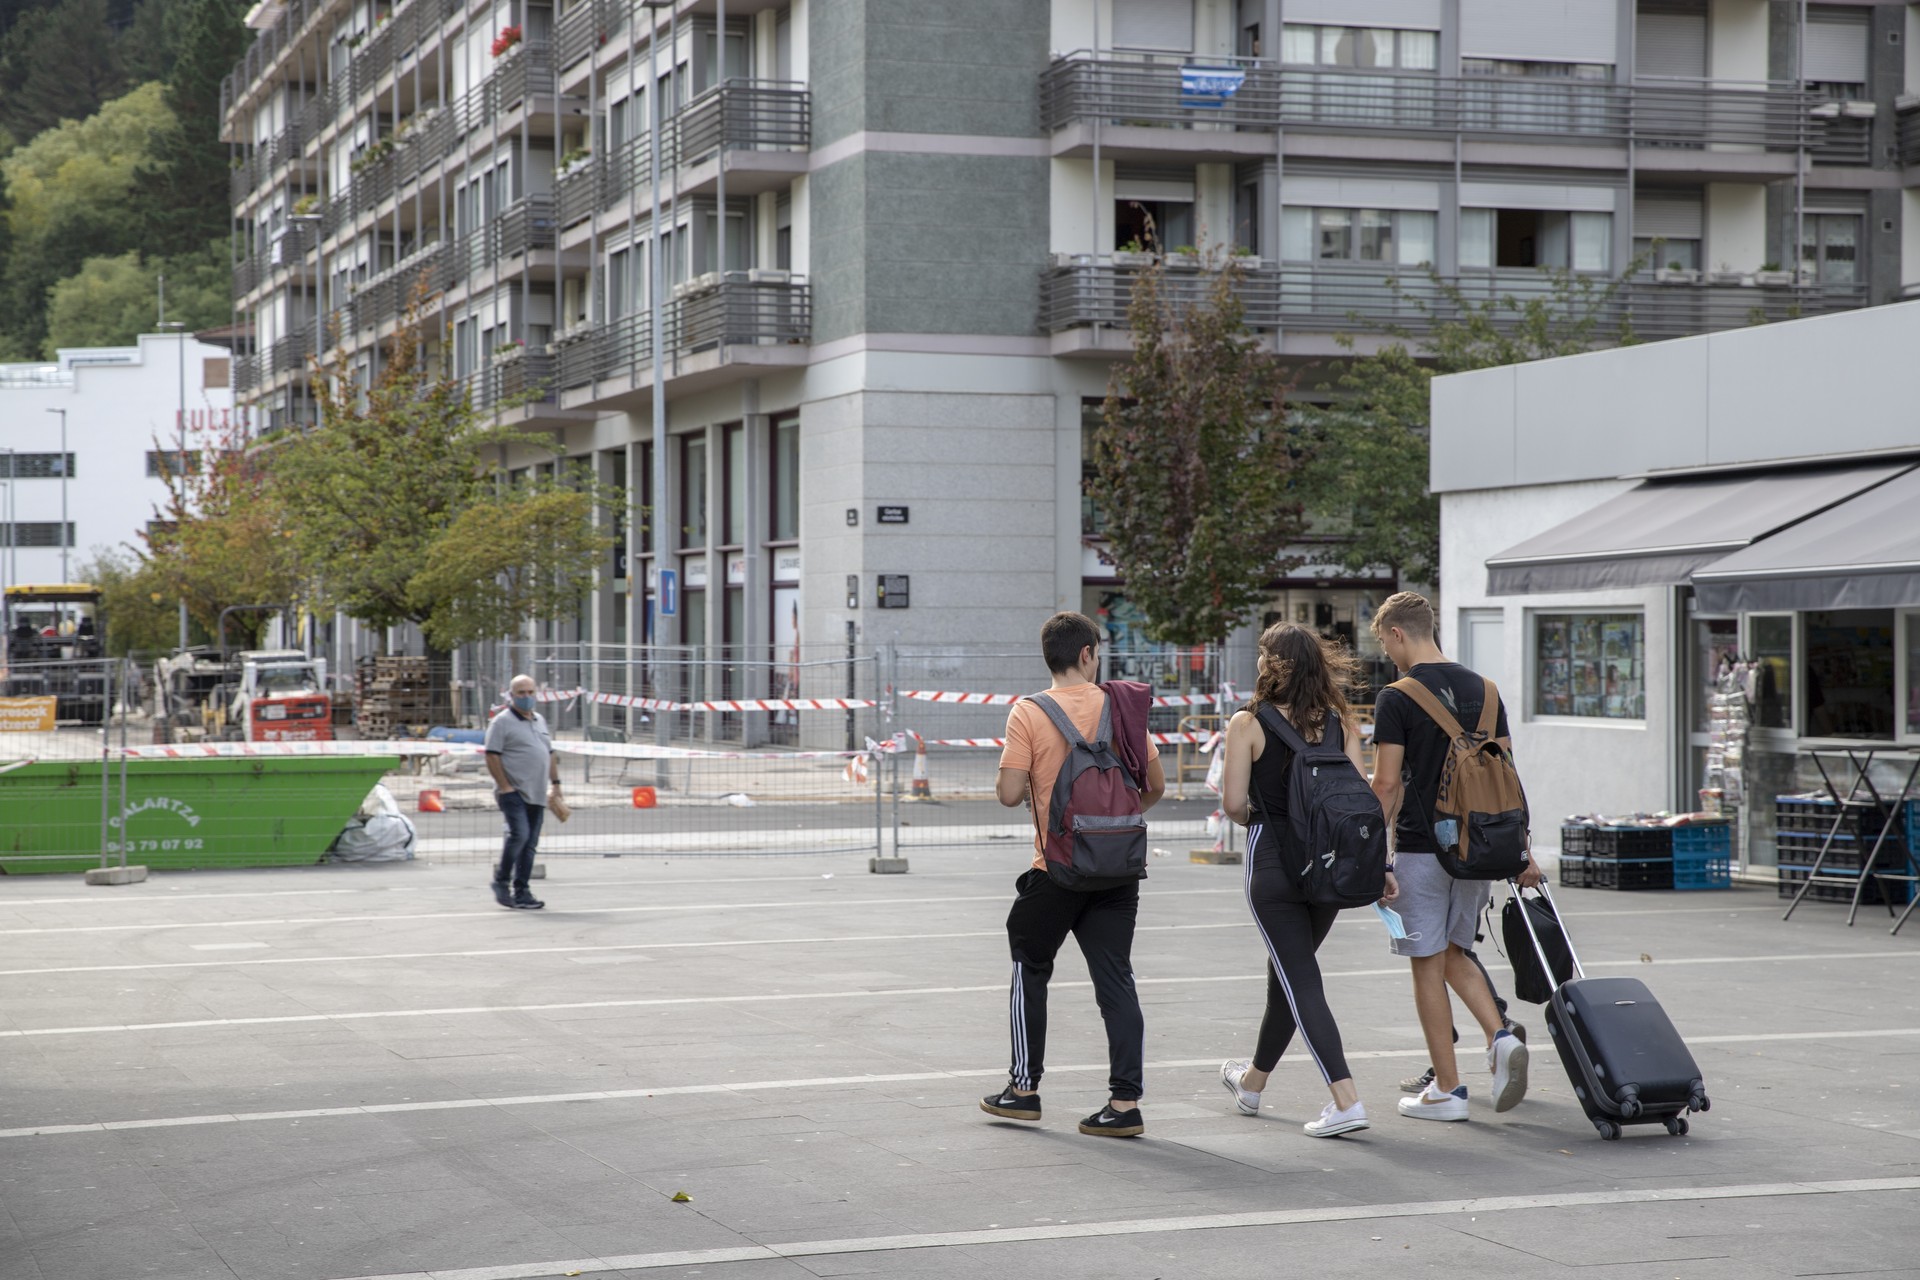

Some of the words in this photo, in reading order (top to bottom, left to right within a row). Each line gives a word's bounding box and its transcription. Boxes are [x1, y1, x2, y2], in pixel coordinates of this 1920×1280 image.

[140, 840, 158, 851] 79
[162, 839, 180, 850] 07
[184, 838, 203, 850] 92
